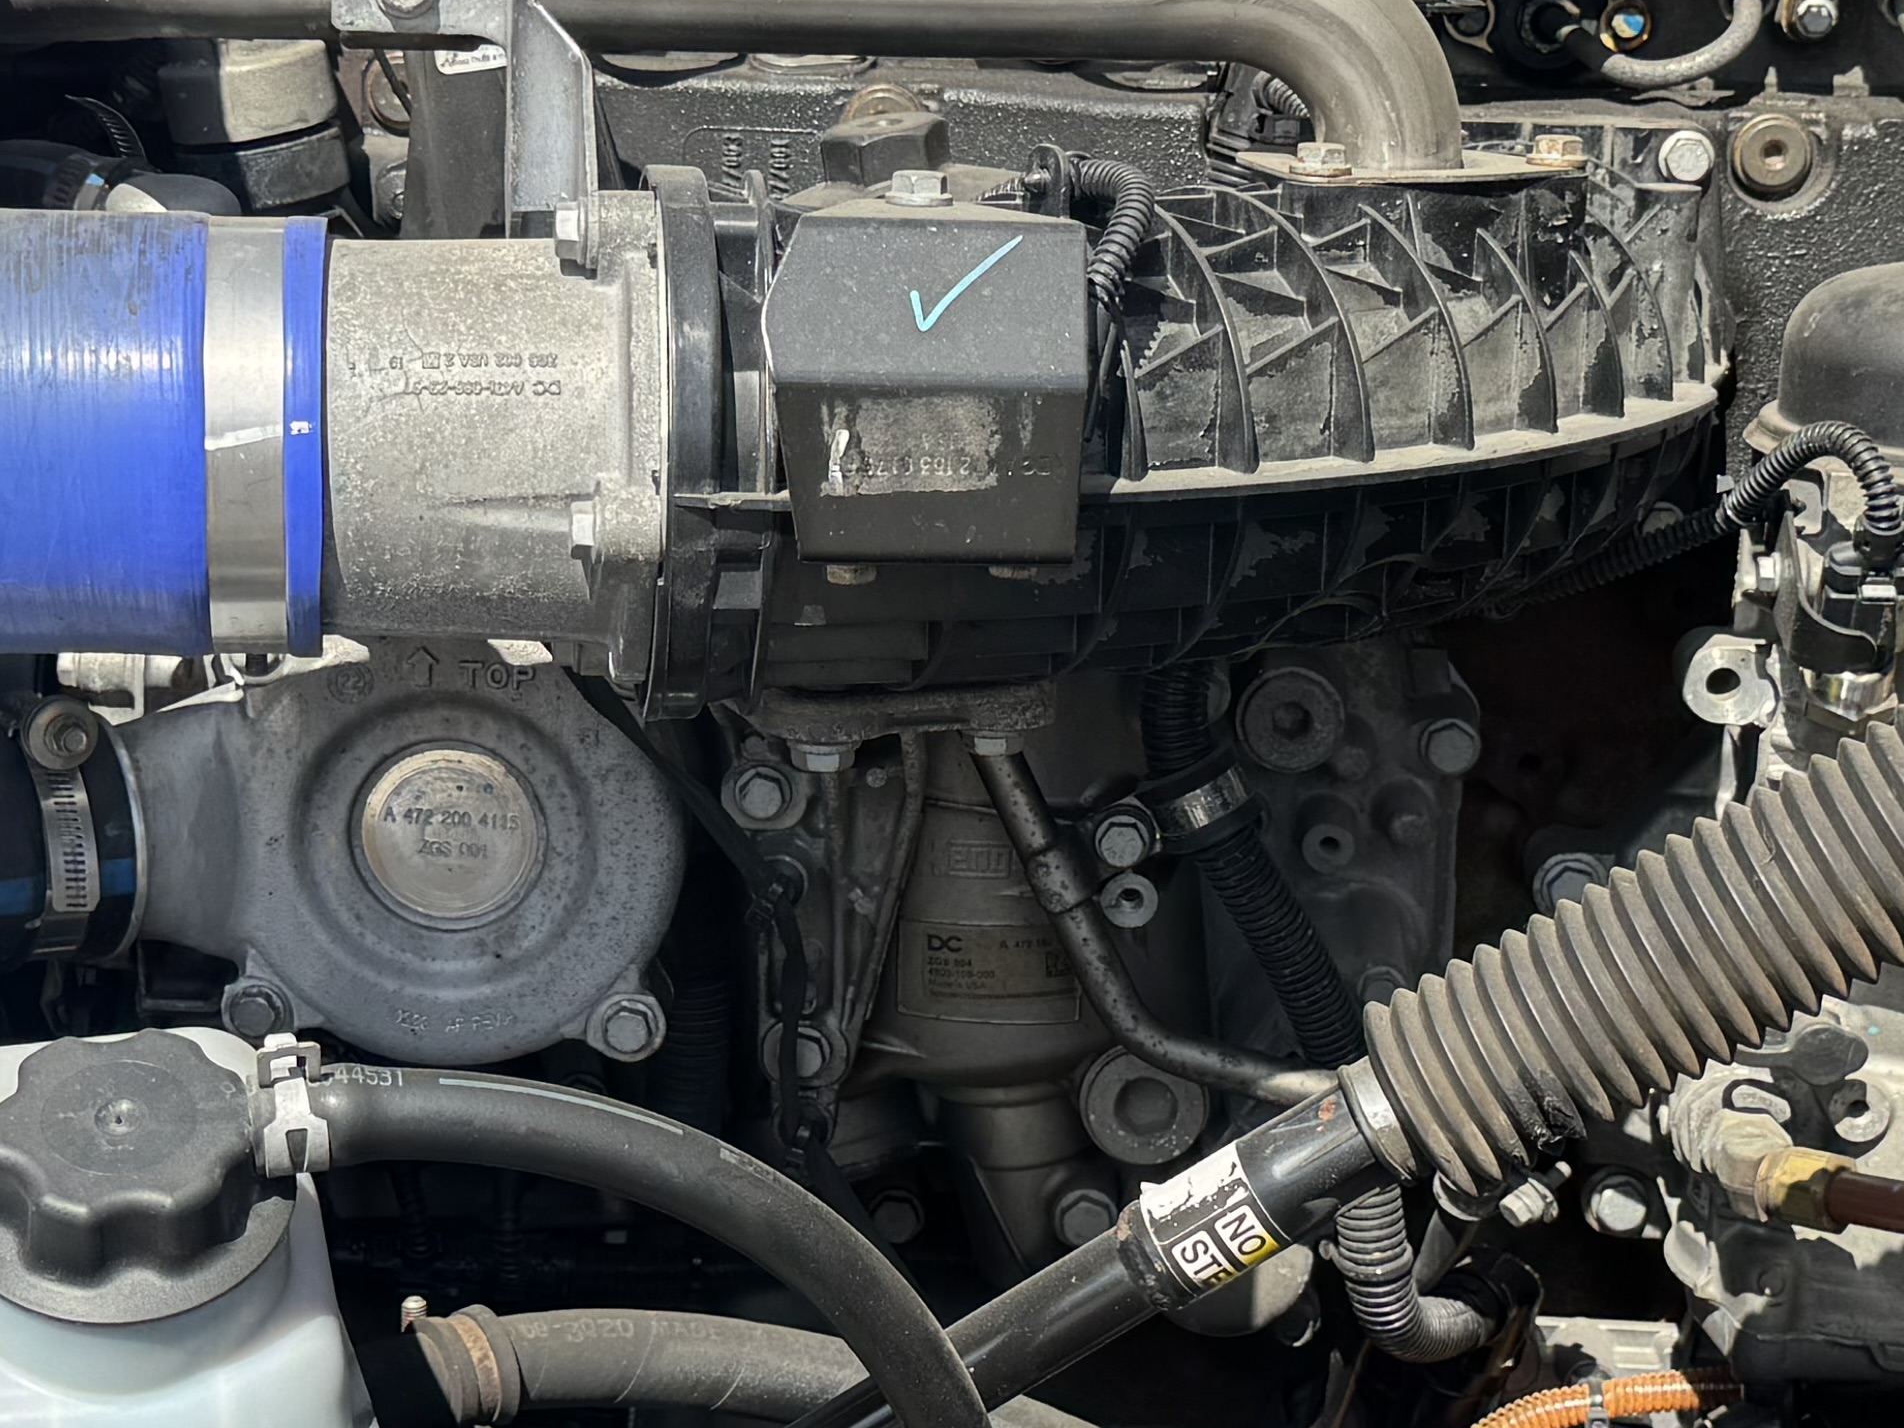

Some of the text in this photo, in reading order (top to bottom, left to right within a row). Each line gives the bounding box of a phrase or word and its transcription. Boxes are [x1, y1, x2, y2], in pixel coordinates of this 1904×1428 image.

[459, 660, 536, 690] TOP
[404, 807, 434, 826] 472
[441, 810, 473, 827] 200
[927, 933, 963, 953] DC
[1220, 1211, 1269, 1257] NO
